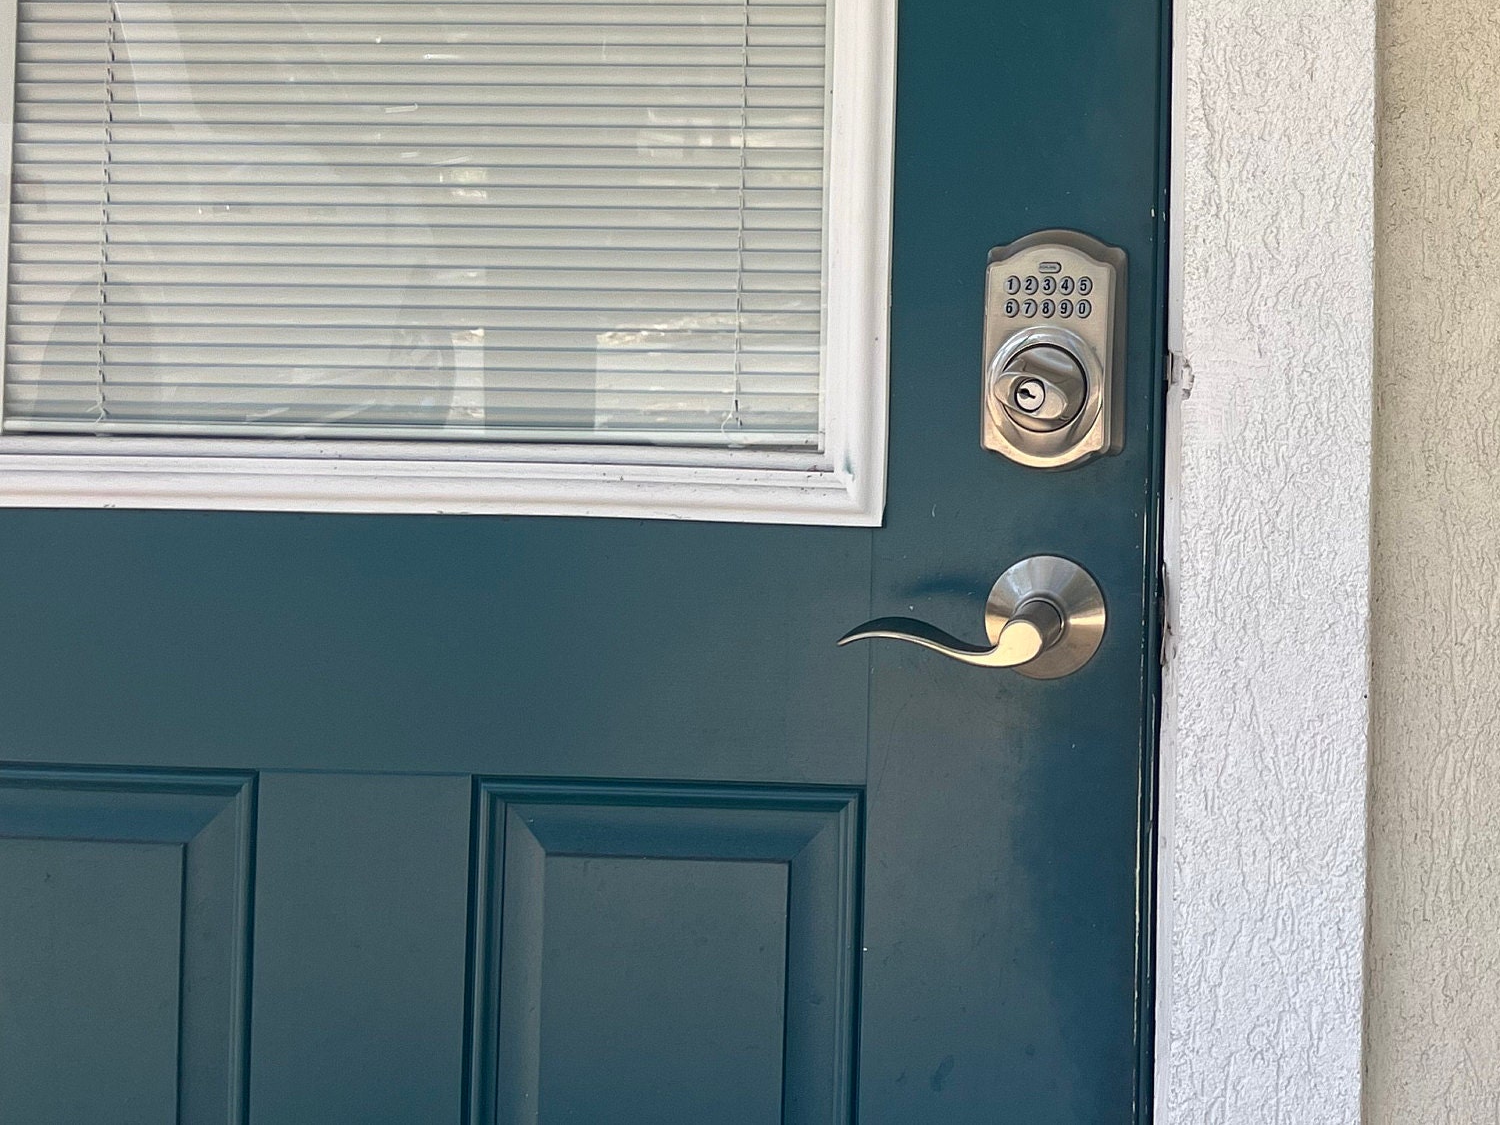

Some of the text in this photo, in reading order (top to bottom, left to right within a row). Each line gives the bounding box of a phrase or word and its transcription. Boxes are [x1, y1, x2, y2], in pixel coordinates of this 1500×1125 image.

[1008, 278, 1087, 291] 1 2 3 4 5
[1006, 302, 1086, 314] 6 7 8 9 0
